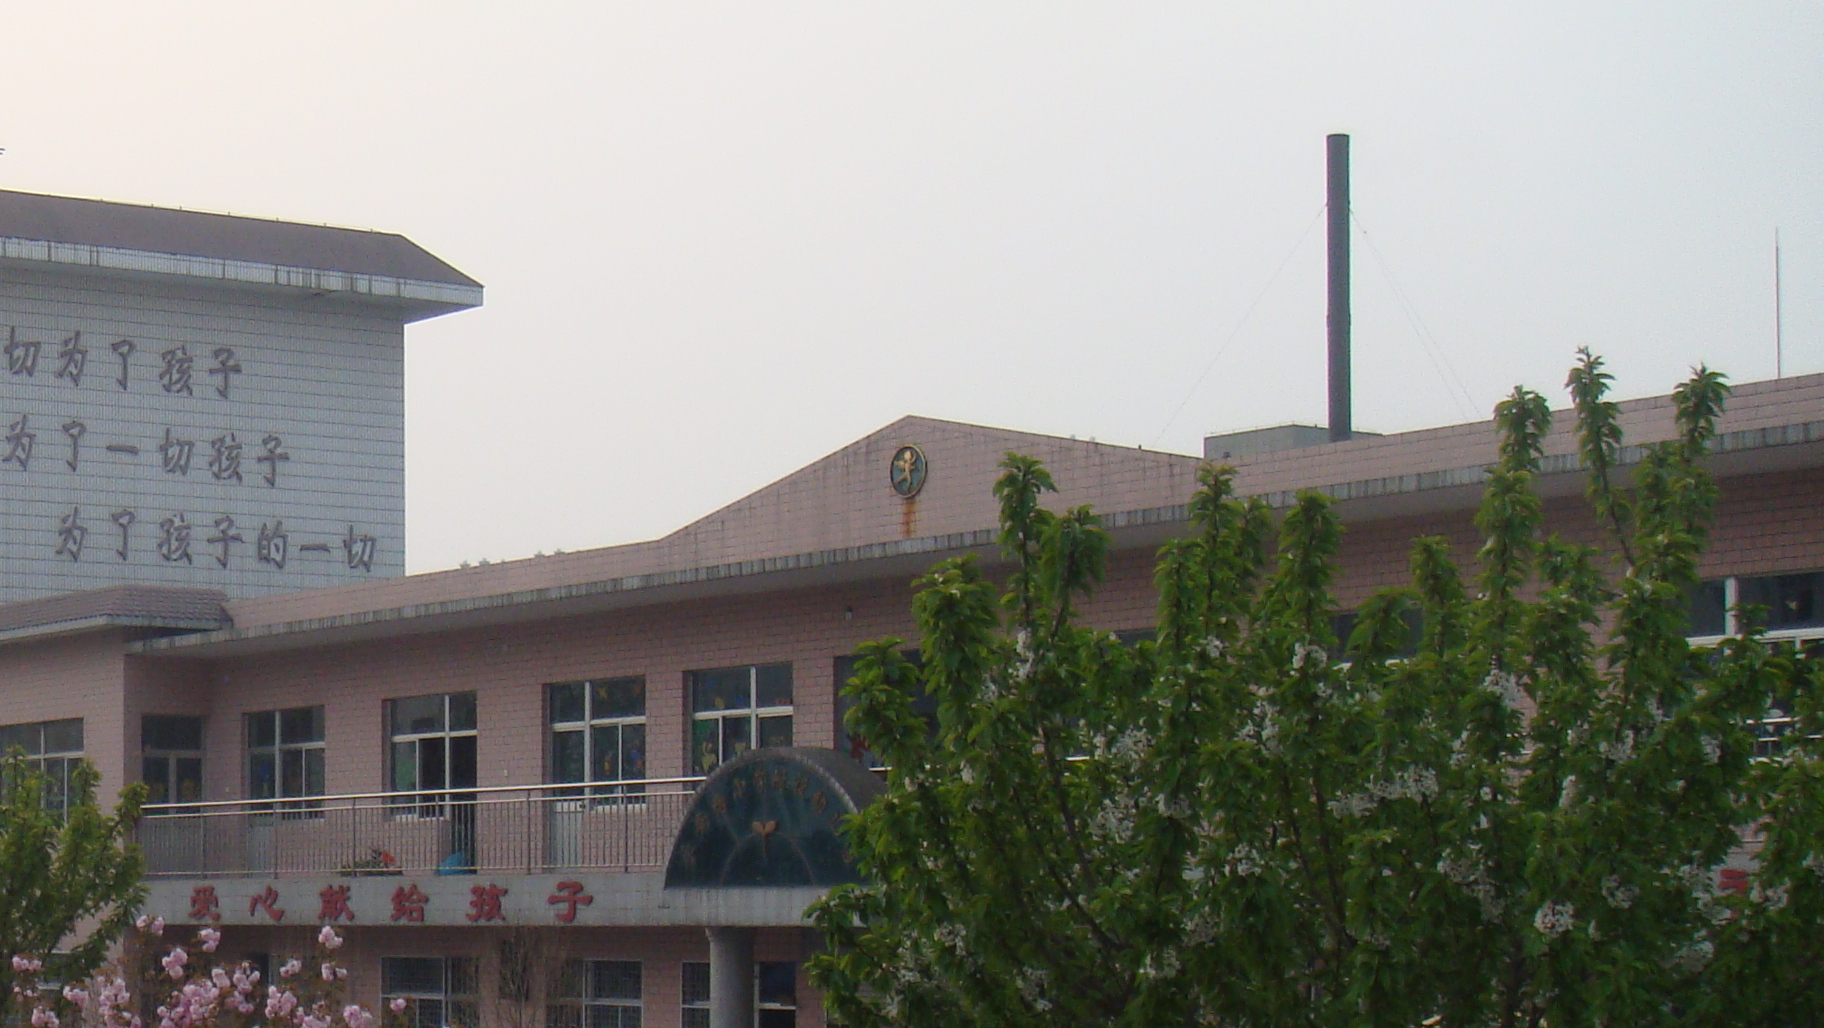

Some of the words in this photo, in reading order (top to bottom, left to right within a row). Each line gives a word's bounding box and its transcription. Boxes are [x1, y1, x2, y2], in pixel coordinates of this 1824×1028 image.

[2, 414, 291, 487] 为了一切孩子
[55, 506, 375, 573] 为了孩子的一切
[188, 880, 594, 924] 爱心献给孩子
